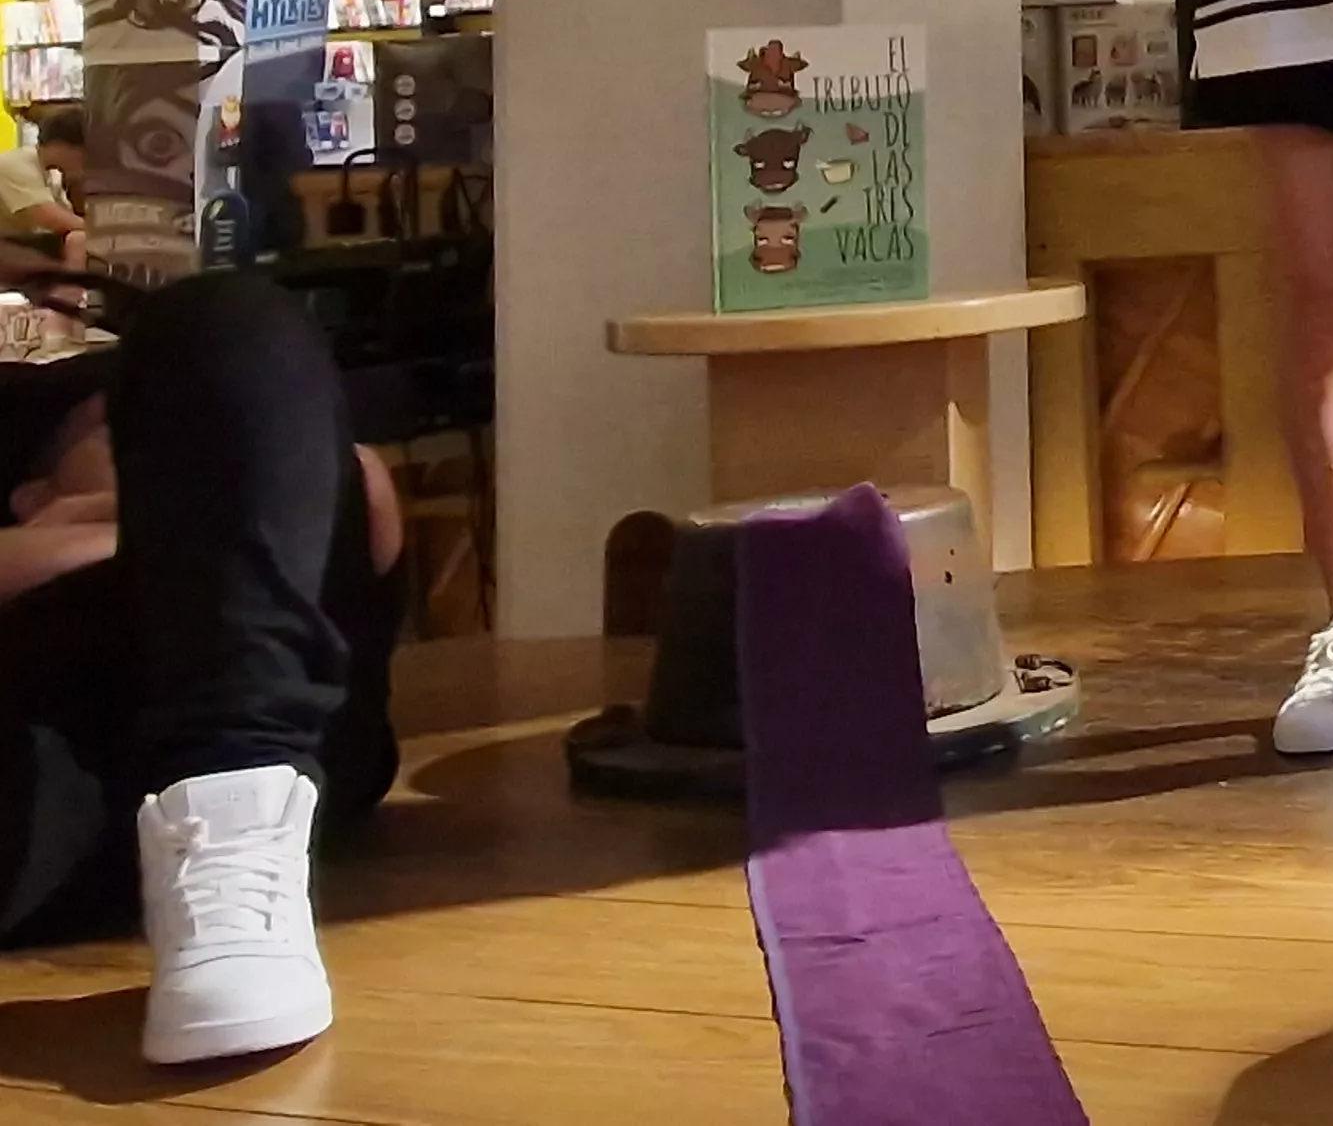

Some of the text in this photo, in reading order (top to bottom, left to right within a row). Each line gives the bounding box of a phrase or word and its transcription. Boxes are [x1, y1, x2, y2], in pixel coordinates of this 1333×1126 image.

[888, 36, 909, 73] EL
[812, 74, 911, 113] TRIBUTO
[871, 149, 913, 187] LAS
[862, 186, 915, 225] TRES
[835, 224, 915, 264] VACAS
